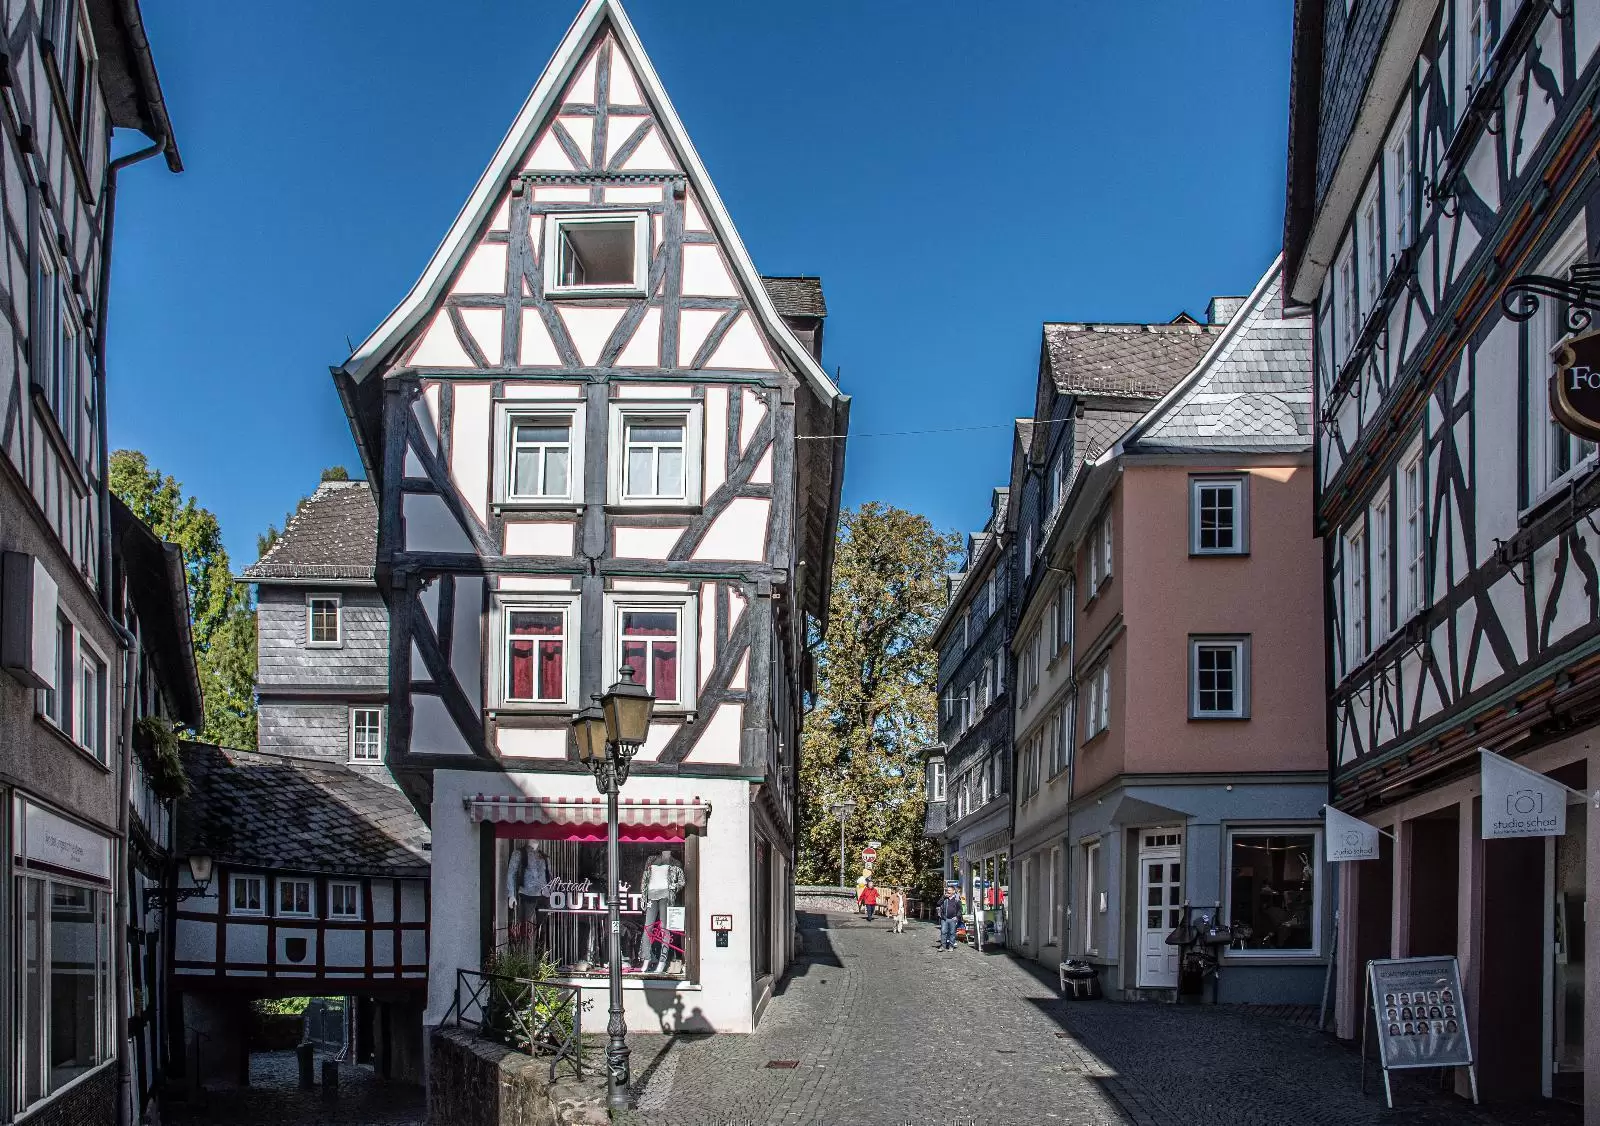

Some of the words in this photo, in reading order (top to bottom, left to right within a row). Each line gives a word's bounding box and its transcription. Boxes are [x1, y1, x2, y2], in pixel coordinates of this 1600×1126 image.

[1570, 366, 1600, 390] Fo
[1493, 817, 1524, 829] studio
[1526, 815, 1557, 828] schad
[541, 876, 593, 892] Altstadt
[549, 891, 643, 911] OUTLET
